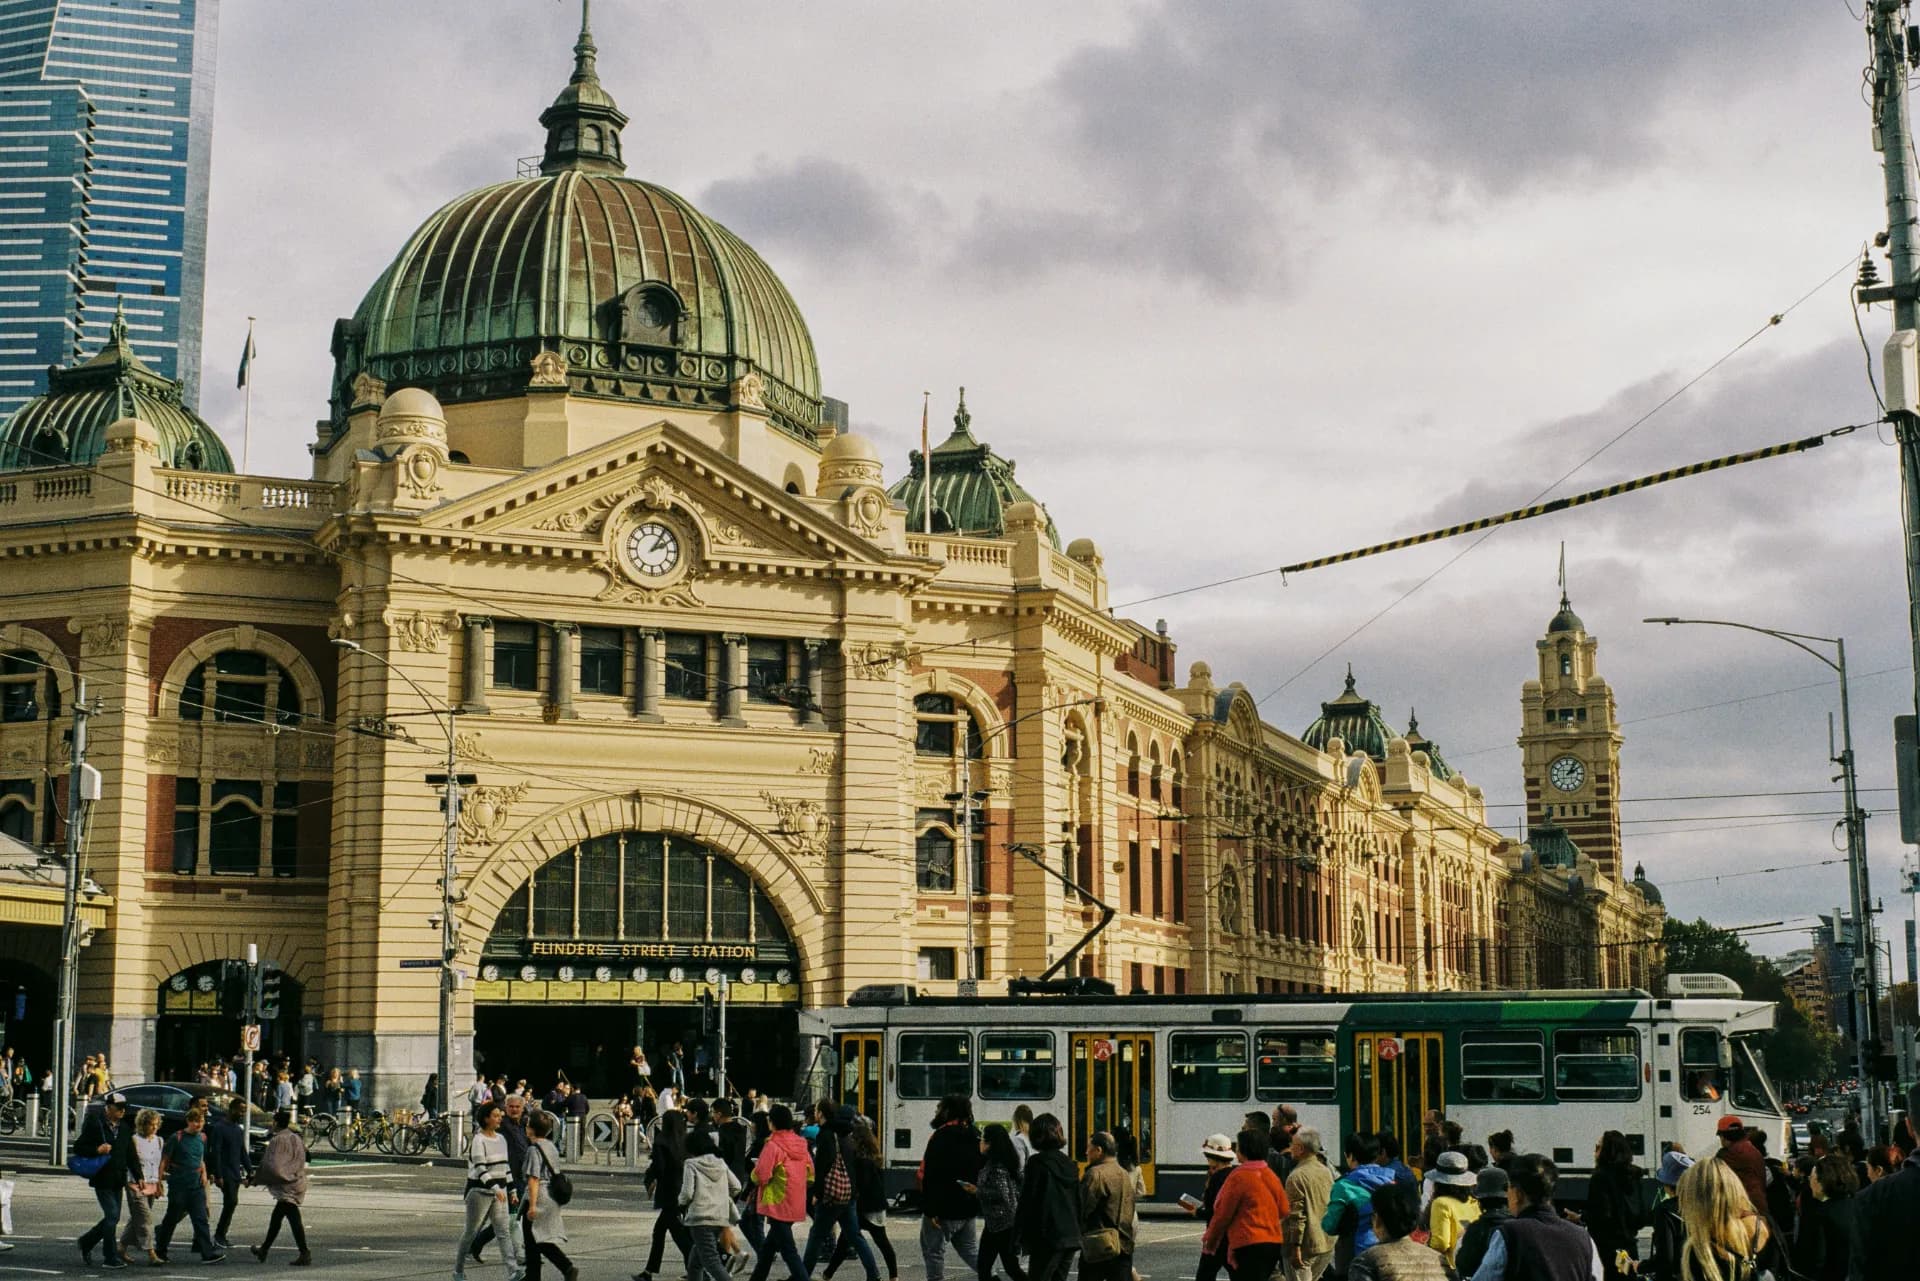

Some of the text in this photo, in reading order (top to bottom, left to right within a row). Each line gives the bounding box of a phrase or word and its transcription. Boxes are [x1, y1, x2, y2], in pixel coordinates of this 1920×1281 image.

[532, 942, 755, 958] FLINDERS STREET STATION
[1693, 1105, 1711, 1114] 254
